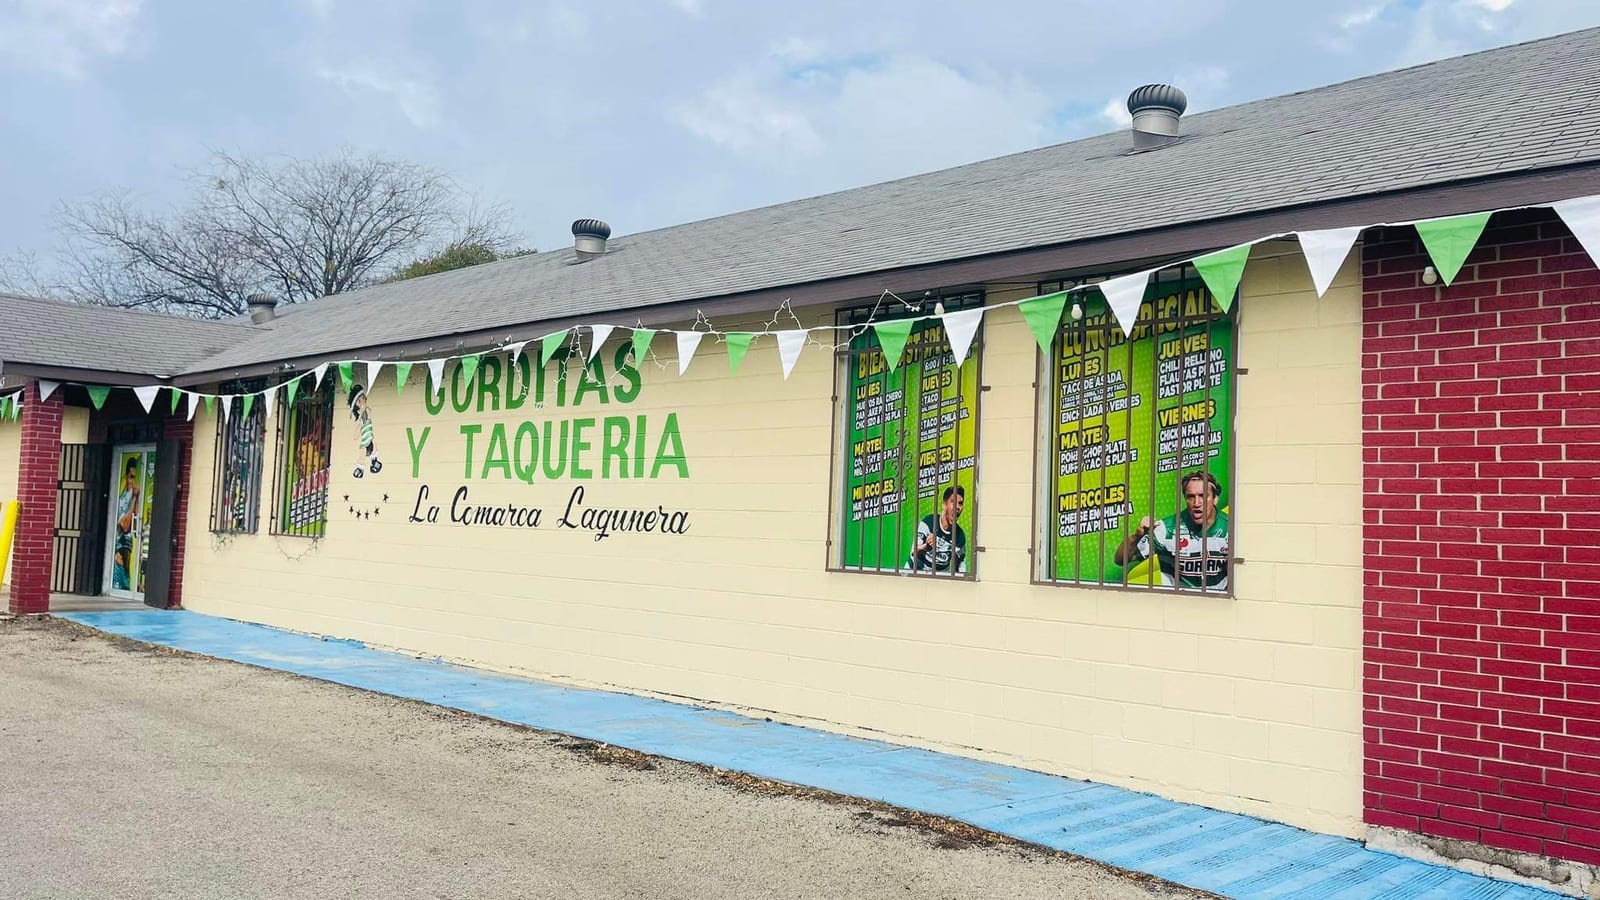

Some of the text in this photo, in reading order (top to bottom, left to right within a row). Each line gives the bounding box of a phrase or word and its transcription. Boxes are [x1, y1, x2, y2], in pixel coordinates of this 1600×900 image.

[1159, 334, 1208, 360] JUEVES
[1159, 349, 1222, 375] CHIL RELLNO
[424, 341, 642, 415] GORDITAS
[1193, 375, 1221, 391] PLTE
[876, 390, 902, 406] RACHERO
[891, 407, 907, 420] PLAE
[1061, 402, 1109, 424] ENCHLADA
[1159, 401, 1215, 428] VIERNES
[1159, 422, 1215, 442] CHICKN FAJIT
[1199, 431, 1222, 447] RJAS
[405, 412, 690, 485] Y TAQUERIA
[886, 447, 901, 460] PLAT
[919, 447, 952, 467] VIERES
[868, 461, 882, 474] PLAT
[1085, 454, 1111, 470] TACS
[1059, 486, 1125, 512] MIERCOLES
[408, 484, 692, 542] La Comarca Lagunera
